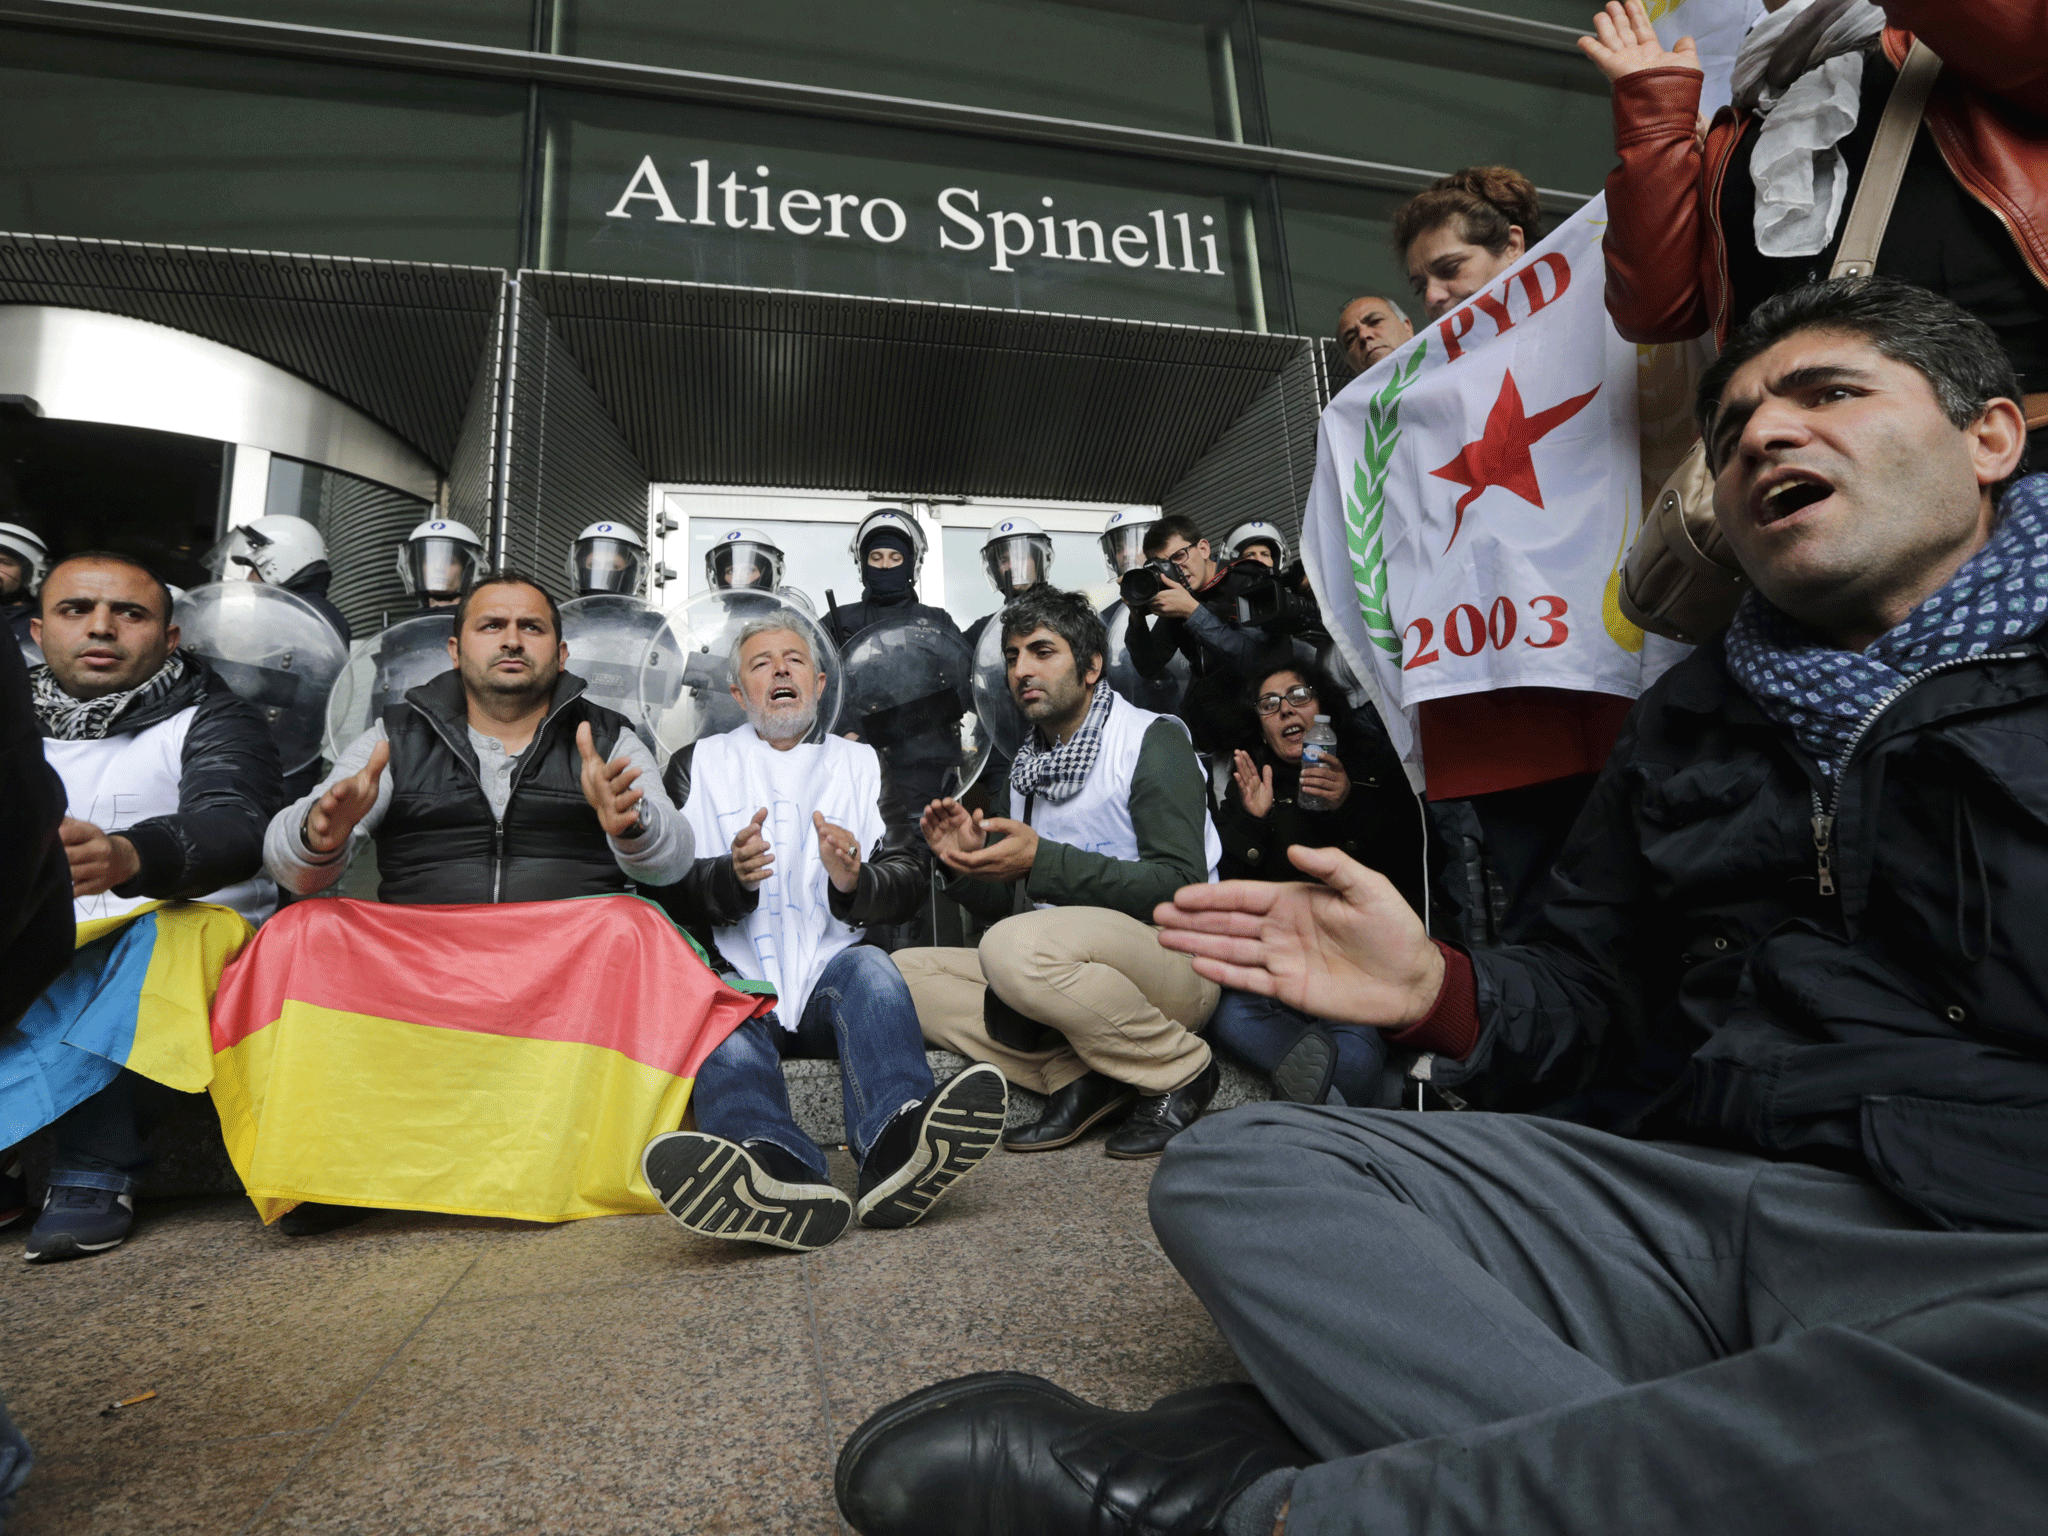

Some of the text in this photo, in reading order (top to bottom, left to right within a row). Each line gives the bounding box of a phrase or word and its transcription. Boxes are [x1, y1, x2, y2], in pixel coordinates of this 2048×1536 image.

[606, 154, 1225, 275] Altiero Spinelli
[1437, 252, 1571, 364] PYD
[1403, 595, 1569, 672] 2003
